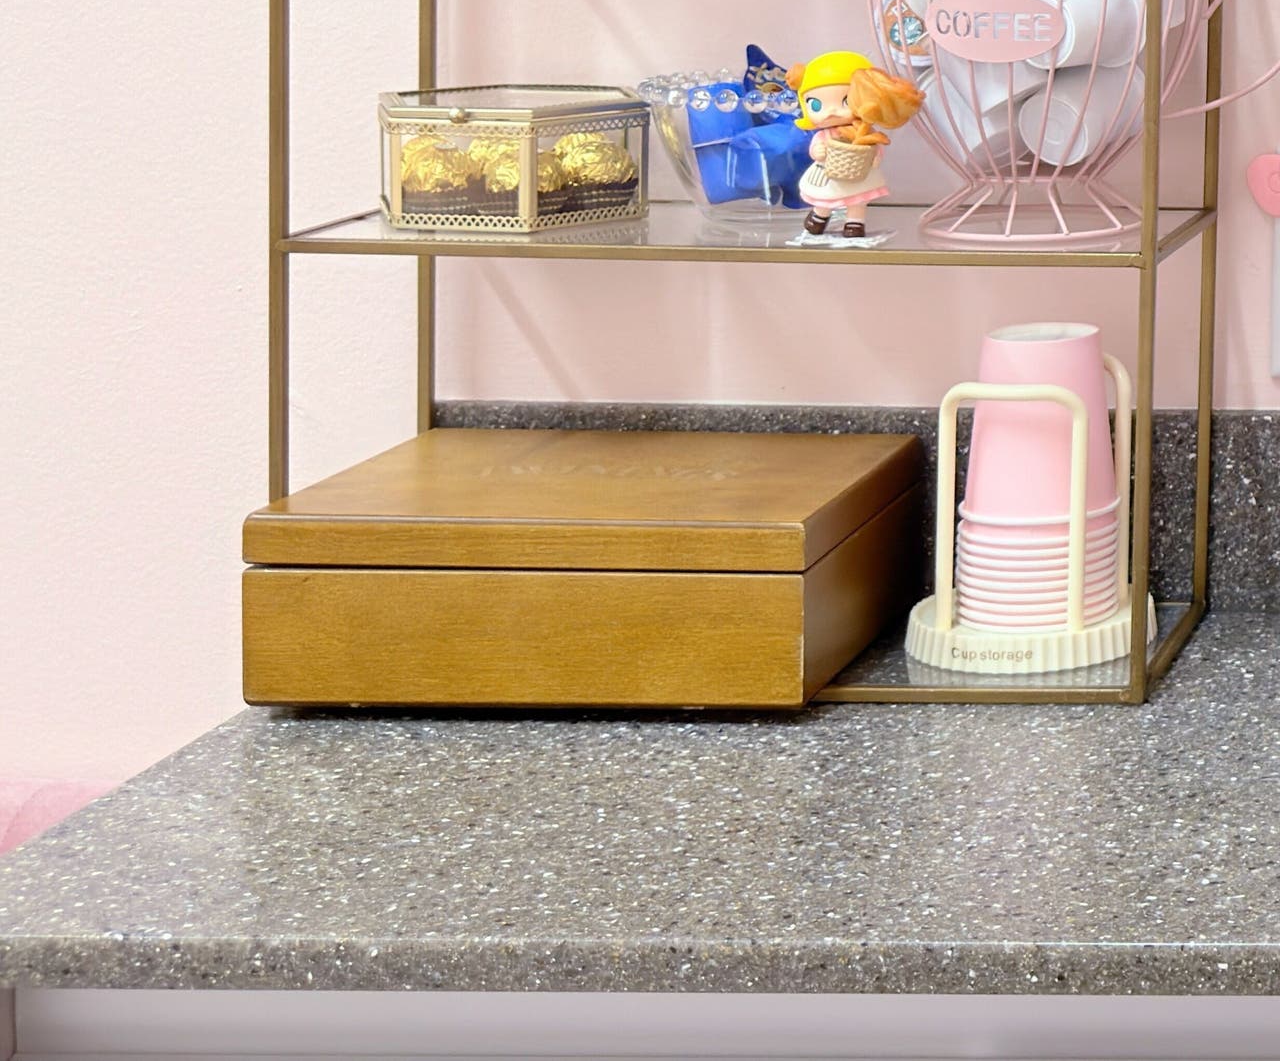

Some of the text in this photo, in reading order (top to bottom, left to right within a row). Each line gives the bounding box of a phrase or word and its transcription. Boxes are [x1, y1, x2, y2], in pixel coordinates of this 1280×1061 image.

[936, 9, 1052, 42] COFFEE
[951, 646, 1034, 662] Cup storage
